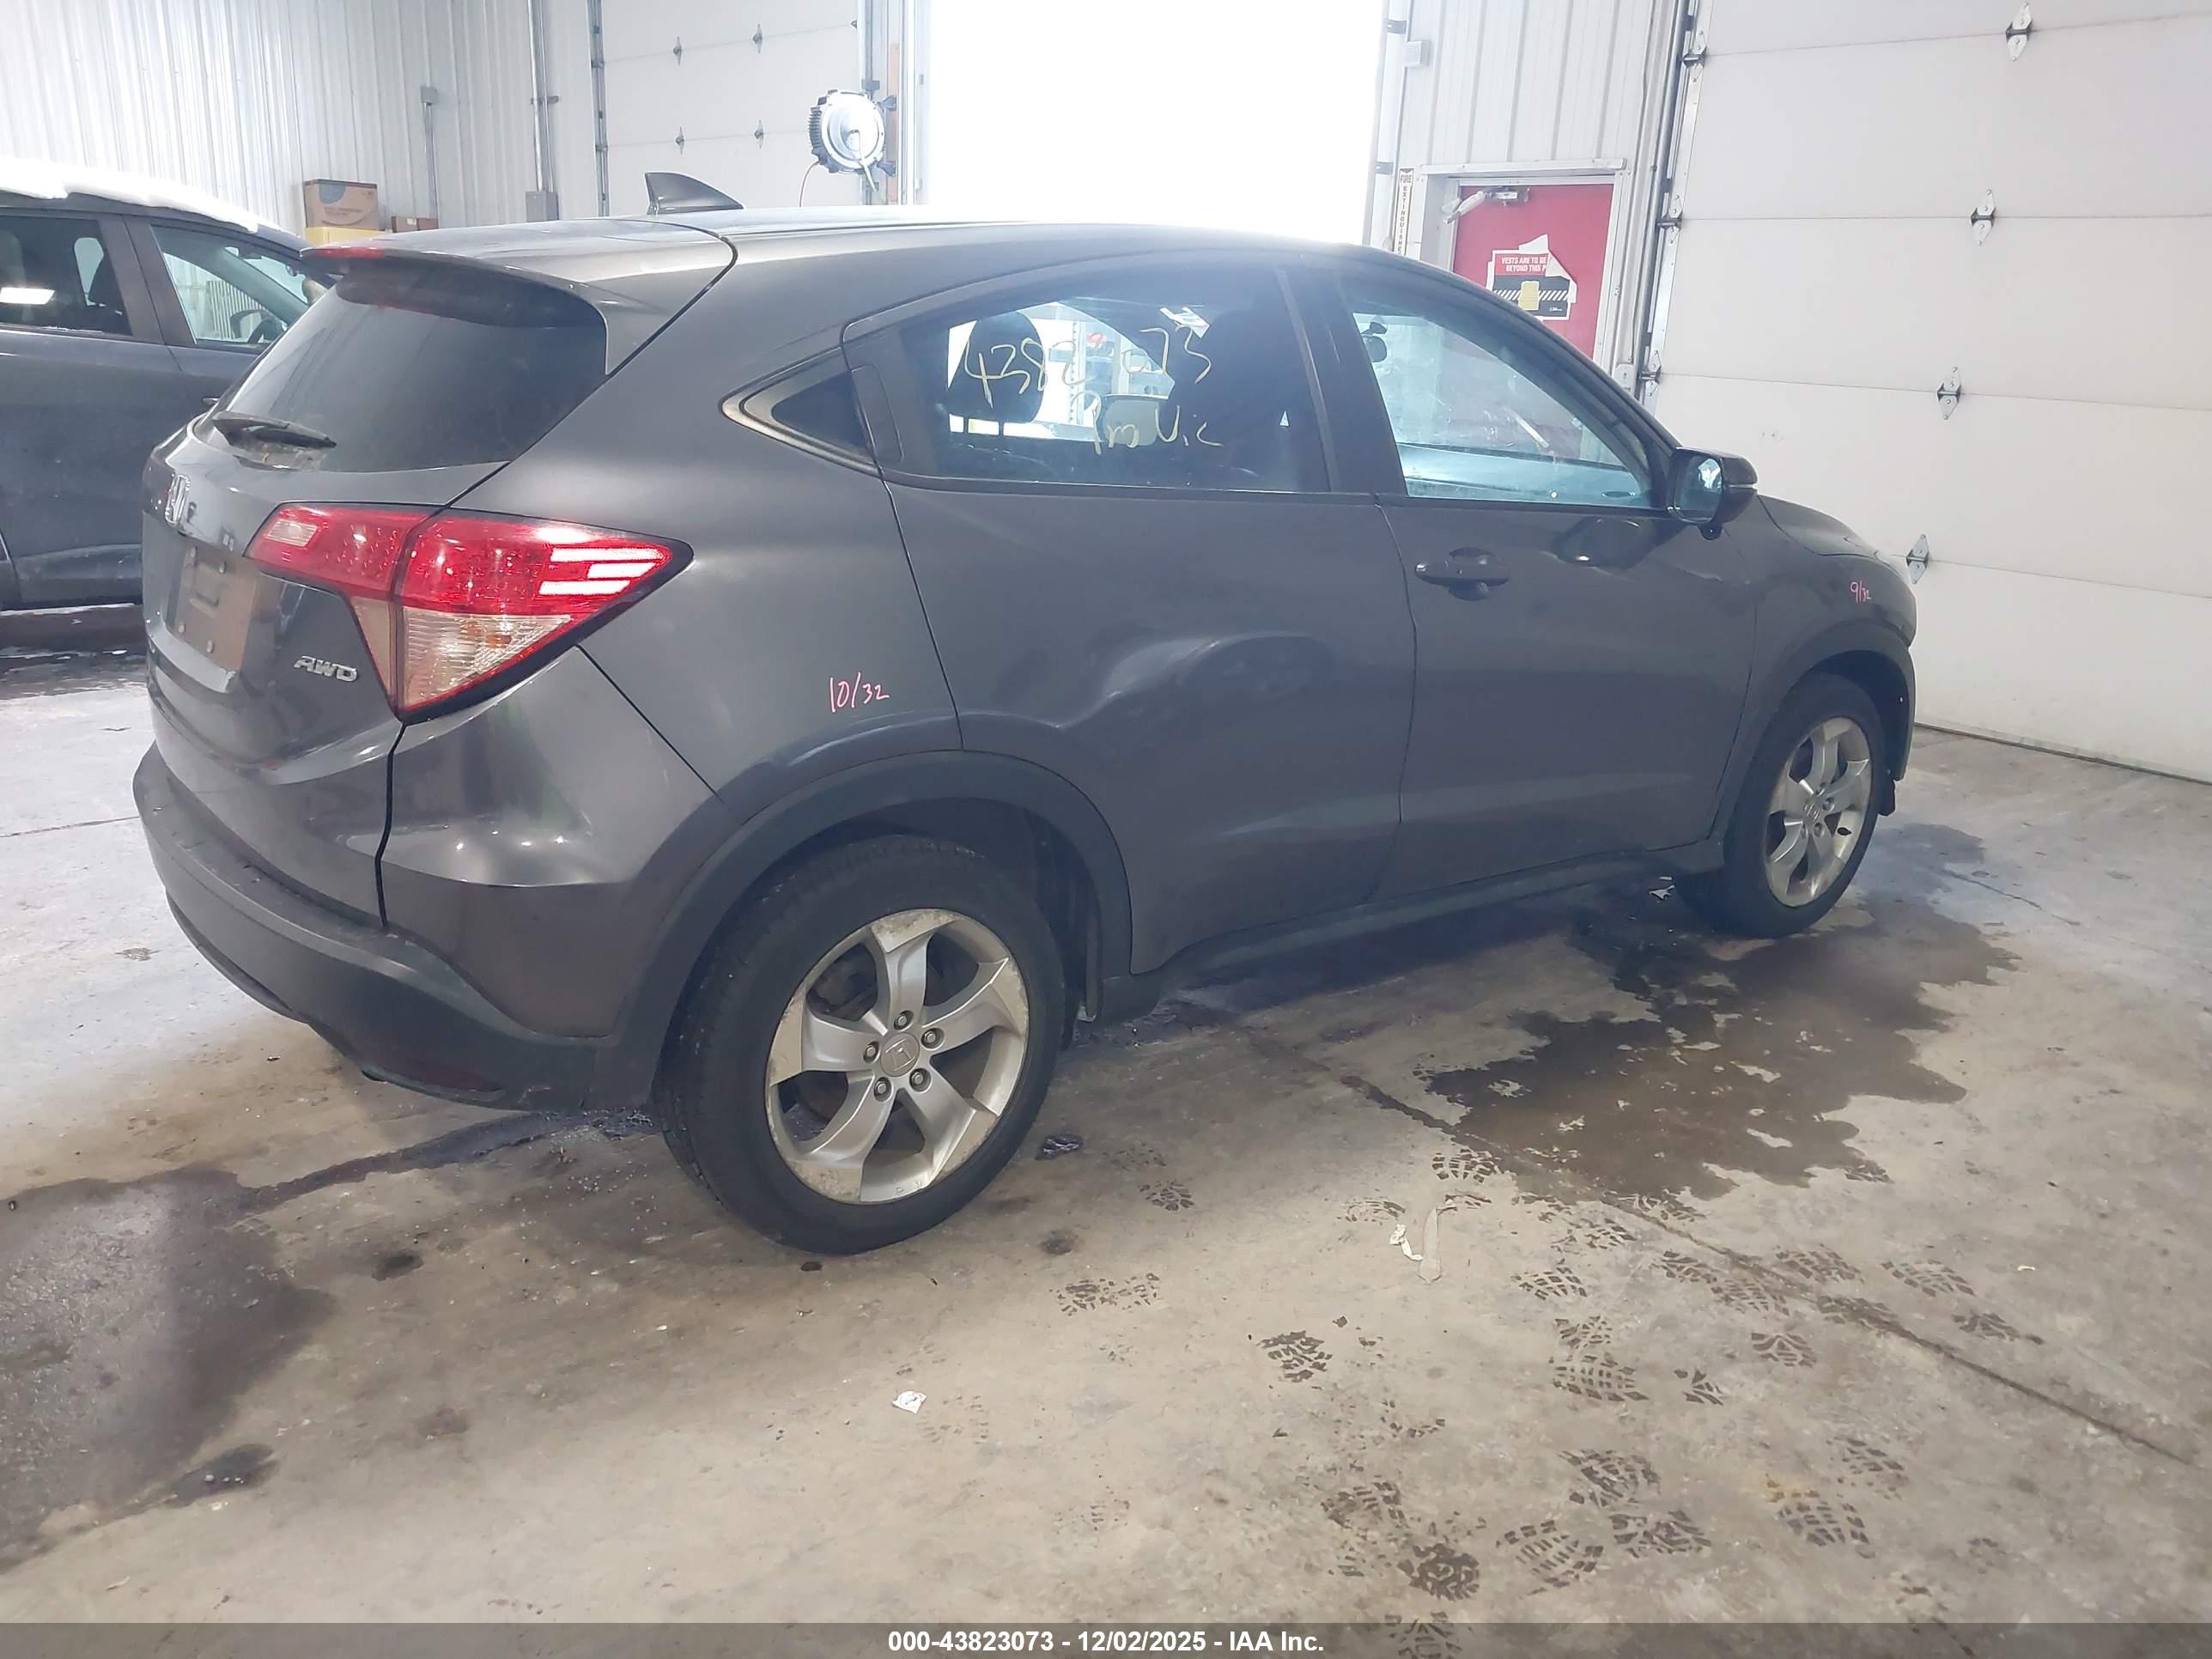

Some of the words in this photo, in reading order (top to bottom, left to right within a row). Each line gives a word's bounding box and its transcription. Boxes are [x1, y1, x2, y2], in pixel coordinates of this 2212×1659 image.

[1501, 256, 1519, 264] VESTS
[1519, 256, 1530, 264] ARE
[1531, 256, 1539, 264] TO
[1505, 264, 1528, 273] BEYOND
[293, 655, 357, 682] AWD
[830, 672, 890, 714] 10/32
